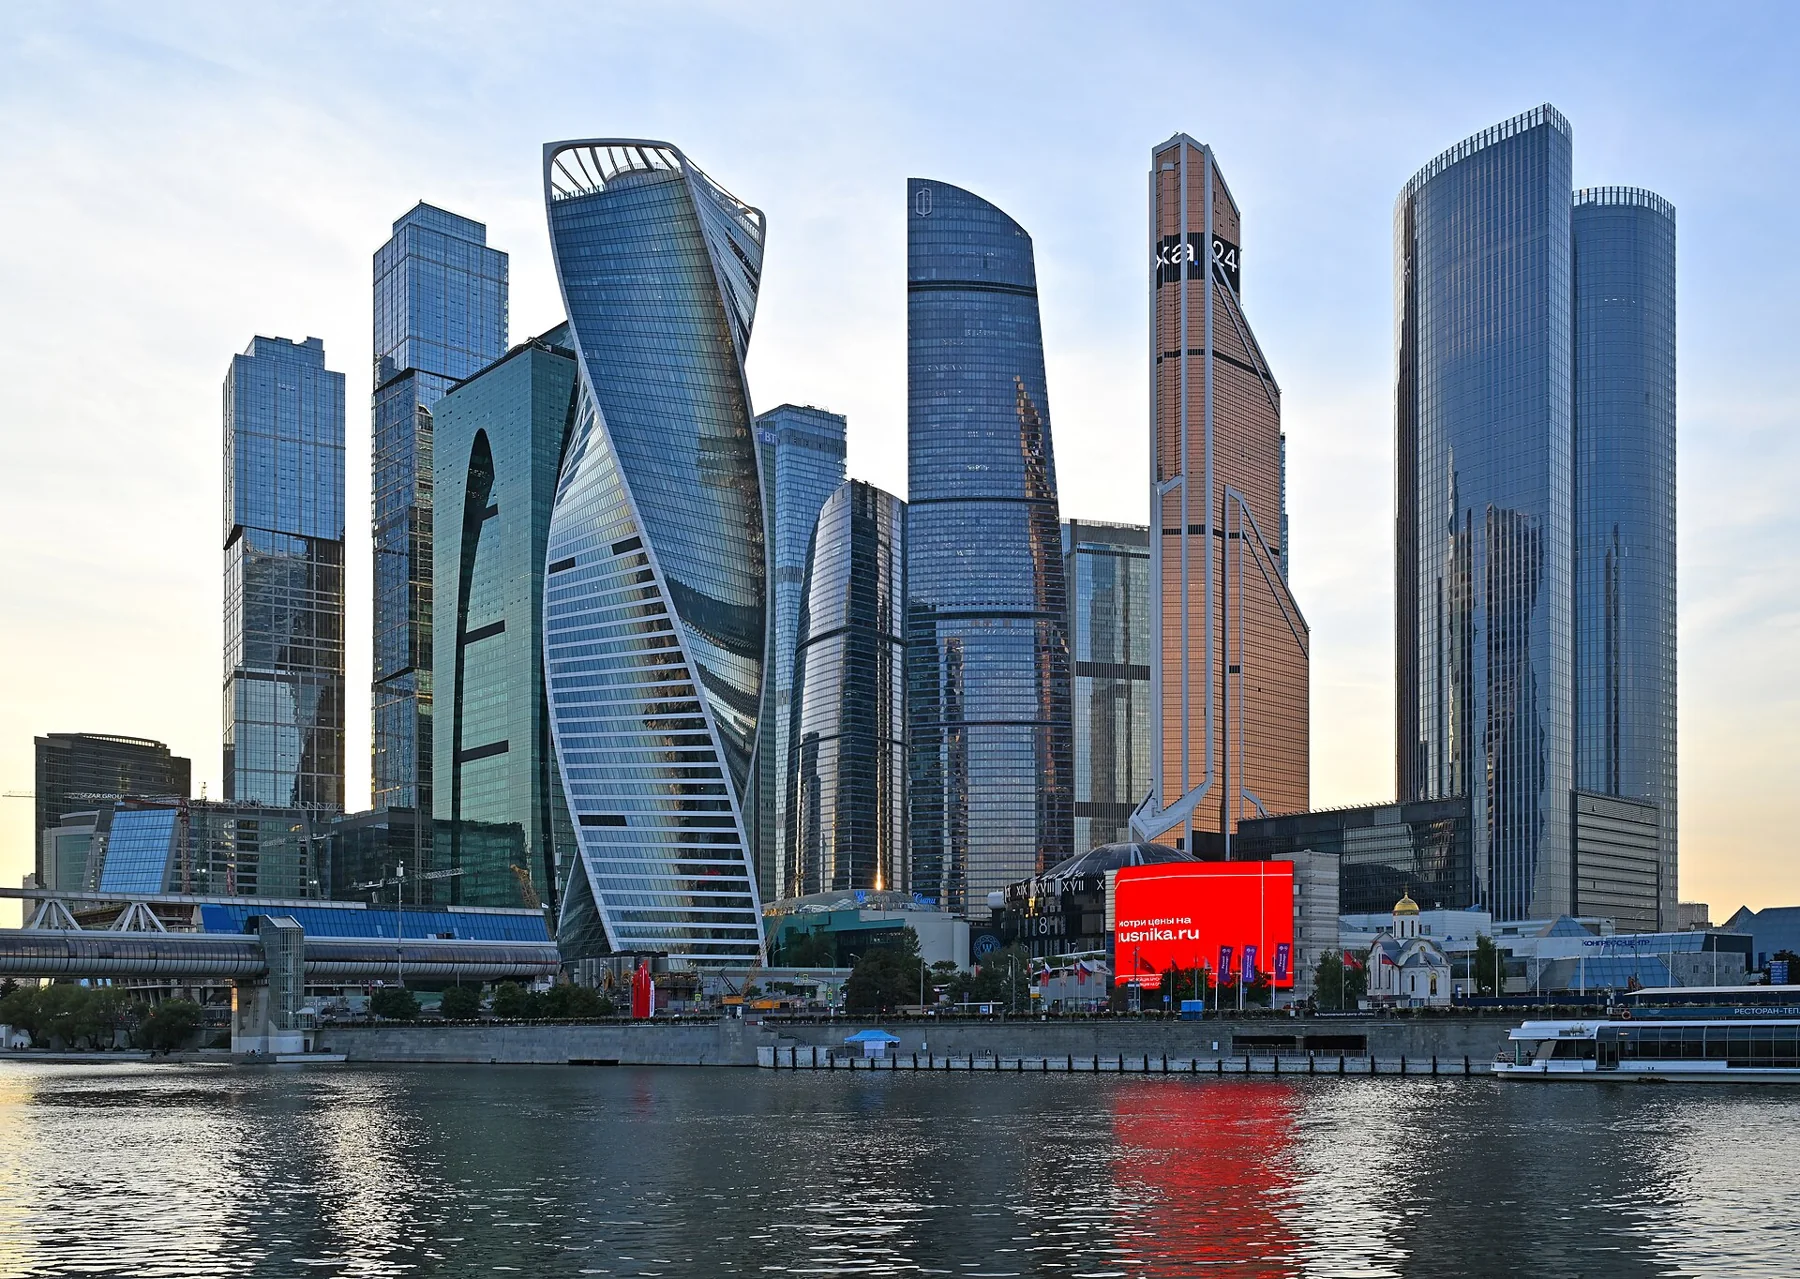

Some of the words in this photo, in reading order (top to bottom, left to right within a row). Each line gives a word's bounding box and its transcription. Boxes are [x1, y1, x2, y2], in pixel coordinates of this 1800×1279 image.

[1213, 240, 1238, 272] 24
[1147, 917, 1175, 927] цены
[1176, 917, 1192, 925] на
[1118, 927, 1200, 943] usnika.ru
[1734, 1007, 1800, 1015] РЕСТОРАН-ТЕП
